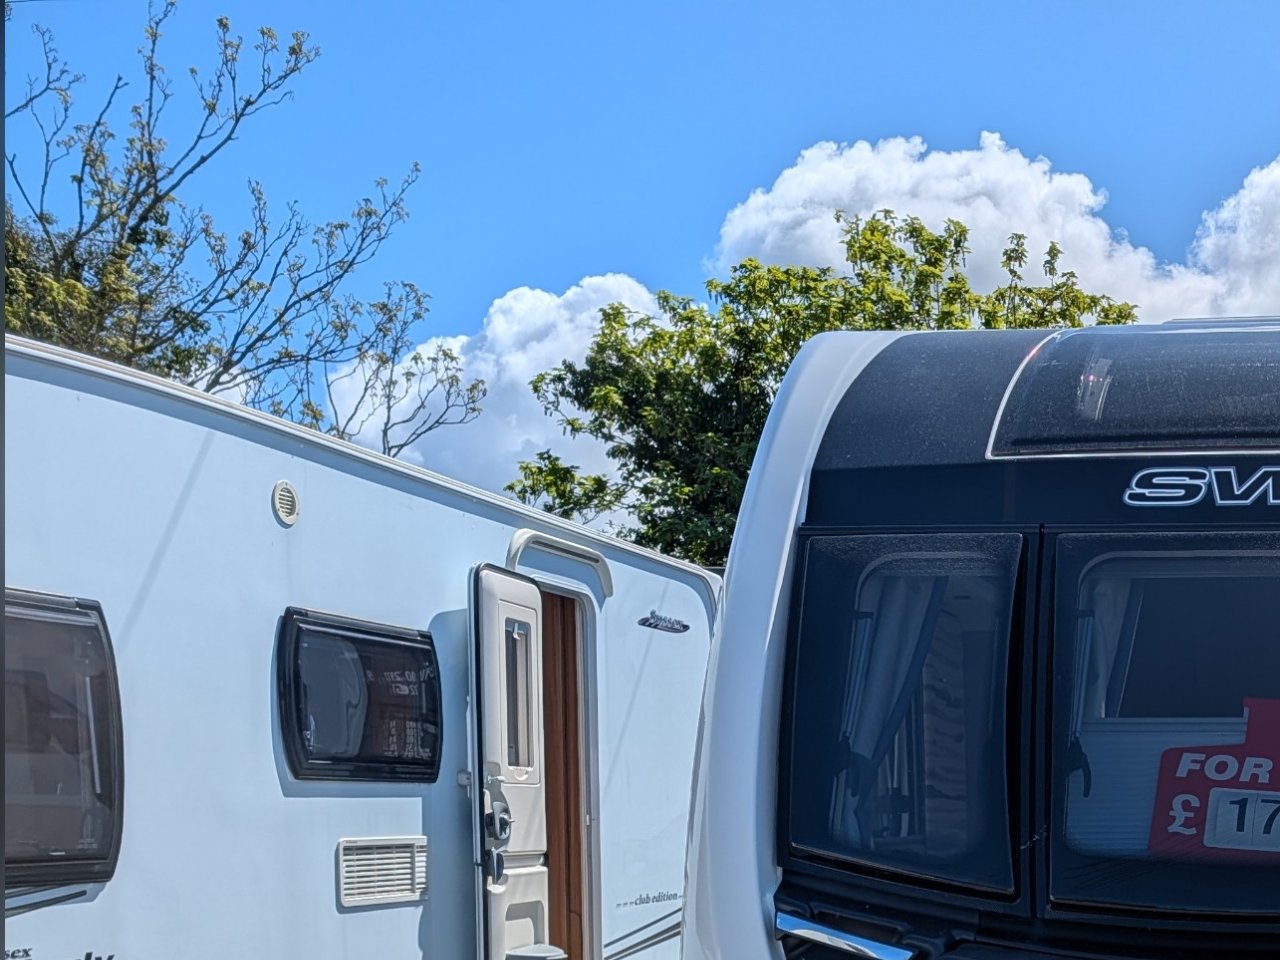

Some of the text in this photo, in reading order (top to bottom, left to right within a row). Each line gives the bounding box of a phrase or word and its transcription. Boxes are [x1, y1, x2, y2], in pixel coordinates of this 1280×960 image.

[1175, 751, 1273, 784] FOR
[1167, 794, 1201, 835] £
[634, 891, 678, 906] club edition
